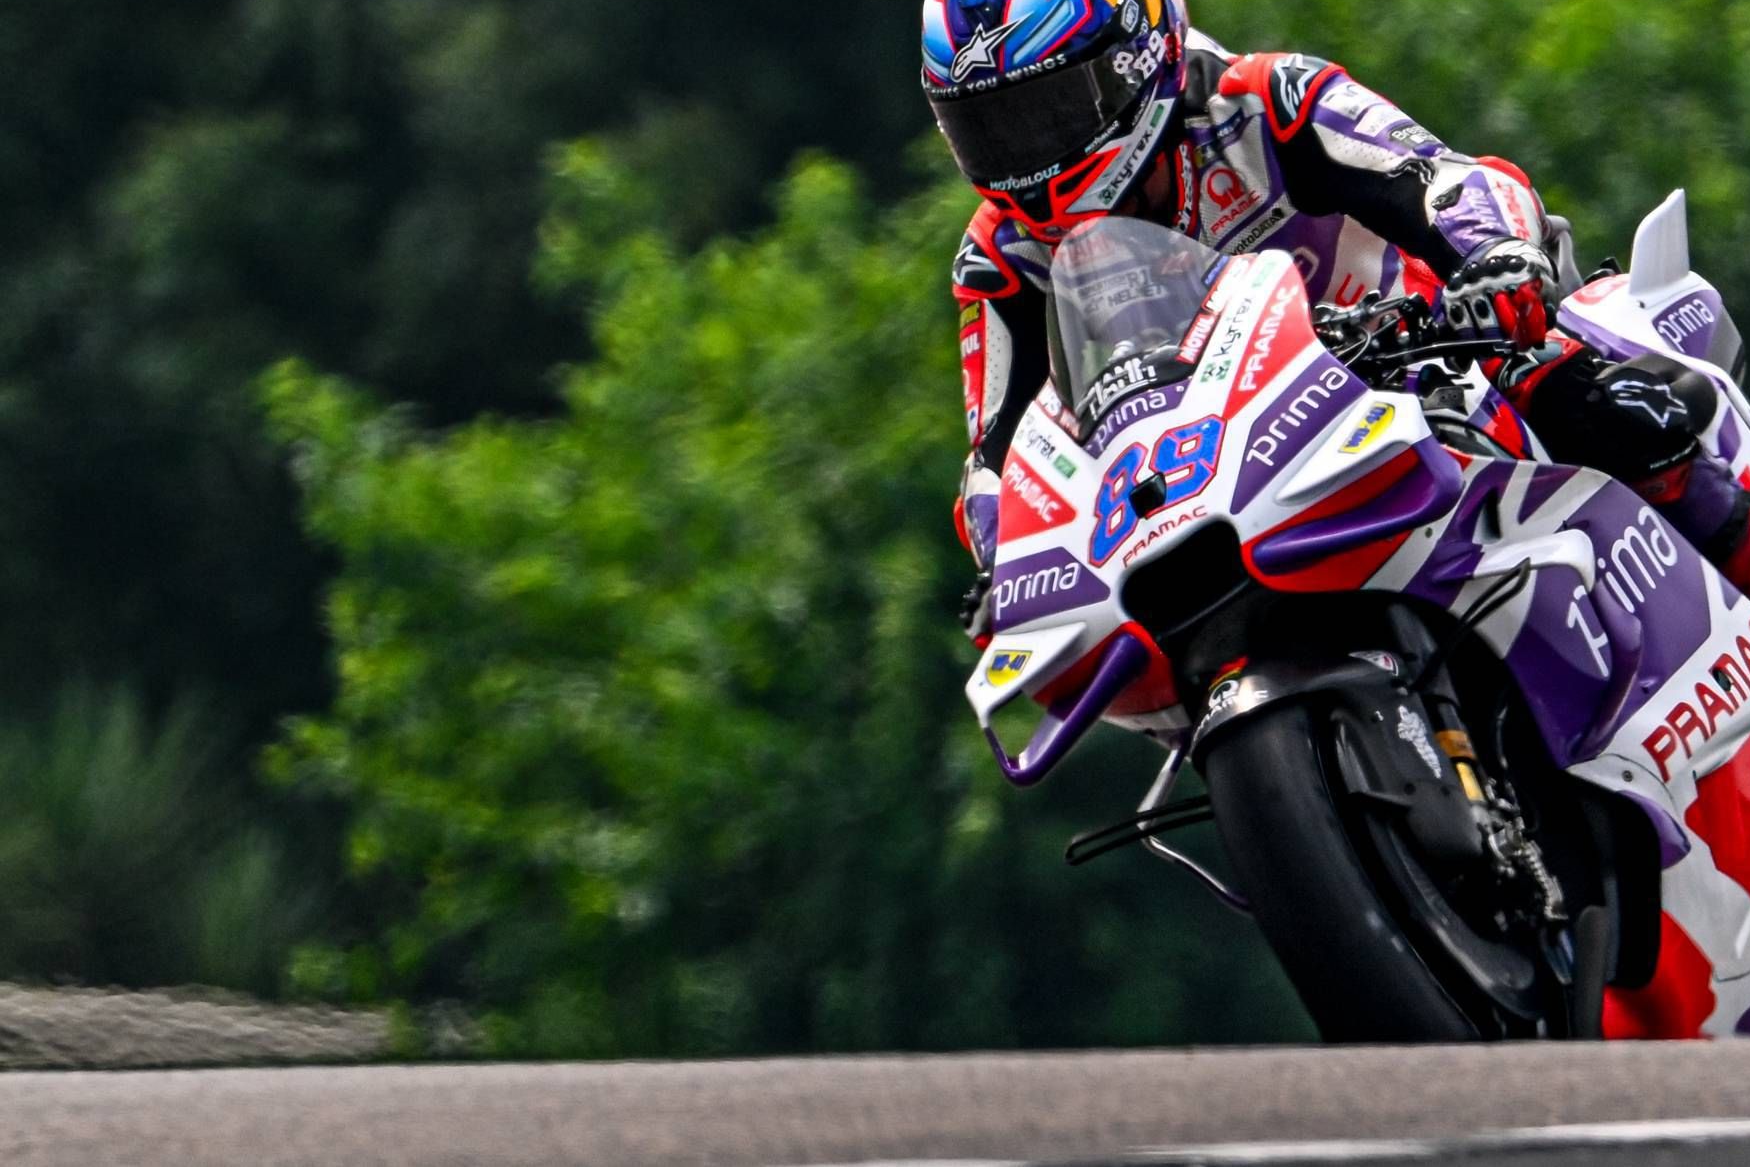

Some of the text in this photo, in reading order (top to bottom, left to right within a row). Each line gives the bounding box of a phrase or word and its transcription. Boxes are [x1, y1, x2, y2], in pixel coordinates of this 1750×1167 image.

[966, 76, 998, 93] YOU
[1005, 53, 1067, 82] WINGS
[1238, 285, 1299, 391] PRAMAC
[1658, 299, 1715, 353] prima
[1091, 391, 1167, 452] prima
[1245, 366, 1348, 467] prima
[1001, 462, 1061, 523] PRAMAC
[1088, 413, 1227, 569] 89
[1121, 505, 1209, 568] PRAMAC
[993, 562, 1081, 620] prima
[1567, 506, 1678, 677] pima
